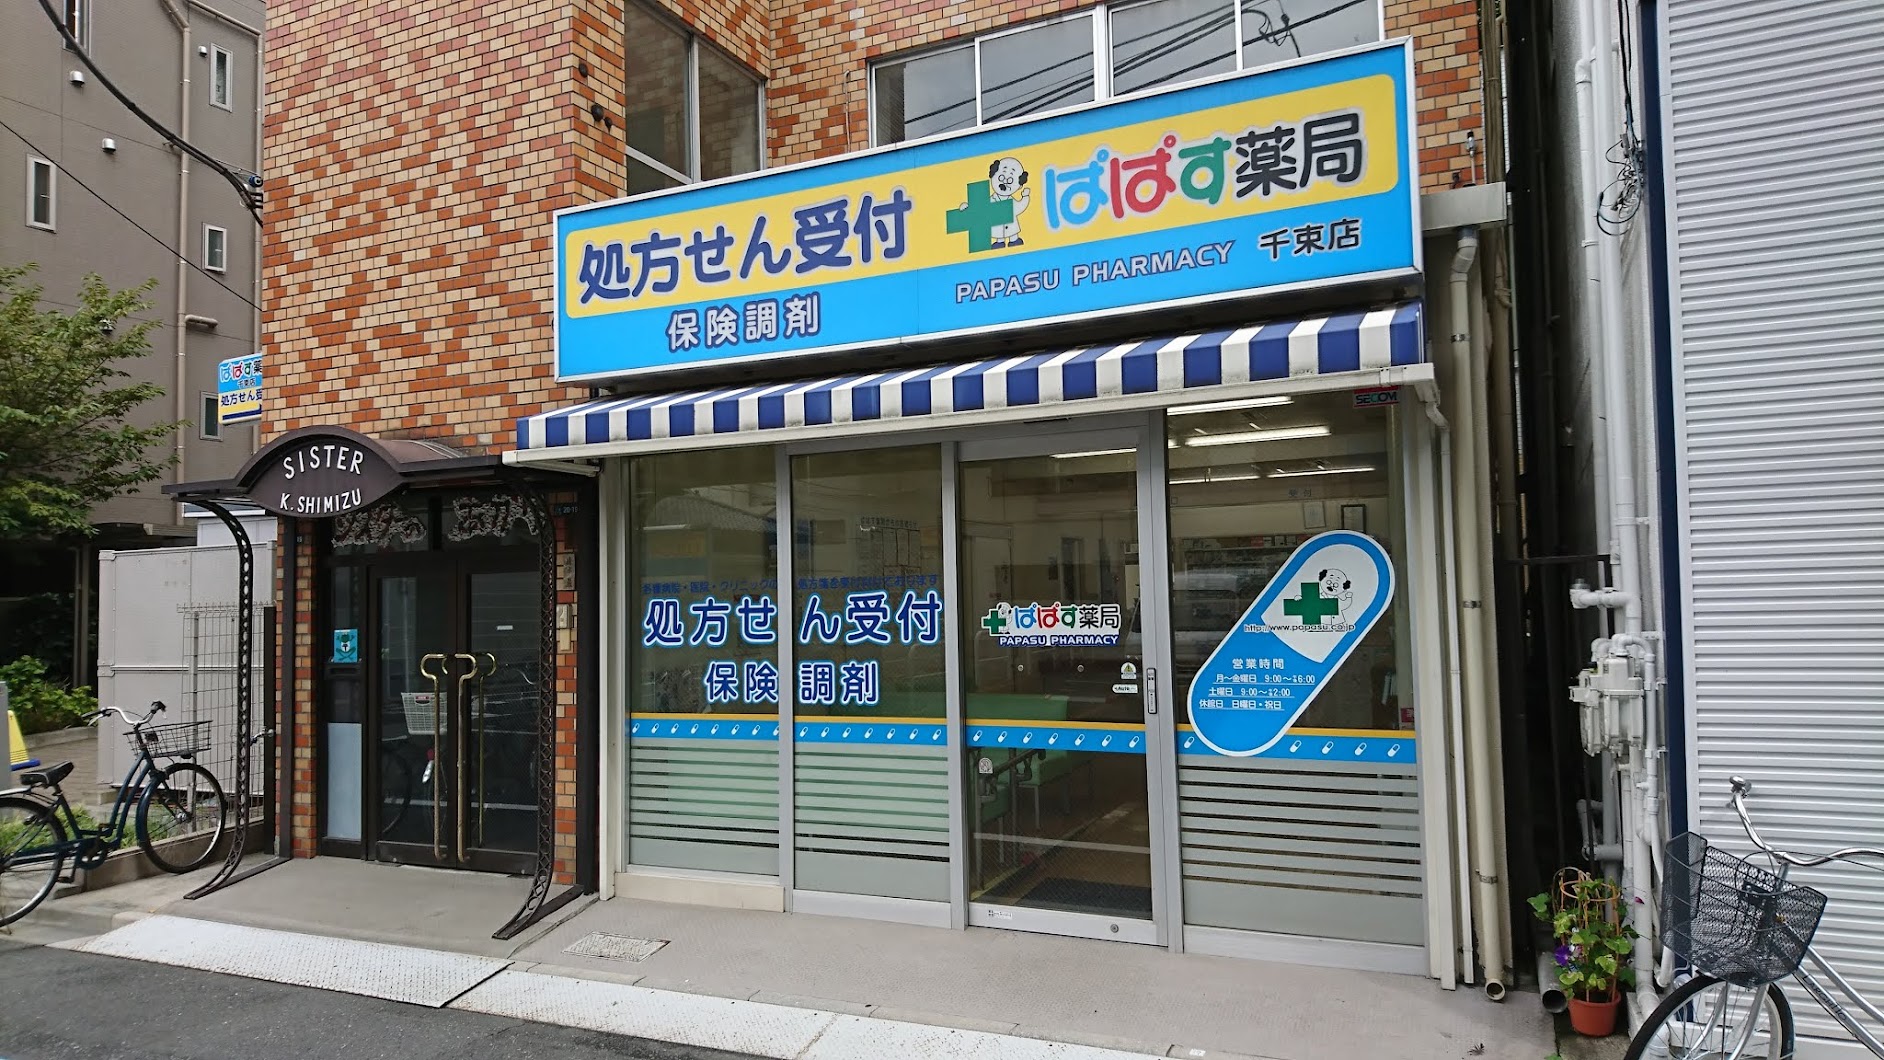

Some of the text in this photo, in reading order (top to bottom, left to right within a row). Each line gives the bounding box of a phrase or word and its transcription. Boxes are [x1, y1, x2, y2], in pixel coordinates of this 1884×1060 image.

[1046, 113, 1363, 229] ぱぱす薬局
[579, 190, 912, 304] 処方せん受付
[1260, 219, 1361, 260] 千束店
[956, 240, 1235, 303] PAPASU PHARMACY
[667, 293, 819, 352] 保険調剤
[1356, 392, 1397, 404] SECOM
[283, 445, 363, 479] SISTER
[644, 592, 942, 645] 処方せん受付
[1015, 603, 1119, 629] ぱぱす薬局
[1000, 635, 1119, 645] PAPASU PHARMACY
[705, 661, 879, 705] 保険調剤
[1232, 658, 1284, 669] 営業時間
[1209, 687, 1233, 696] 土曜日
